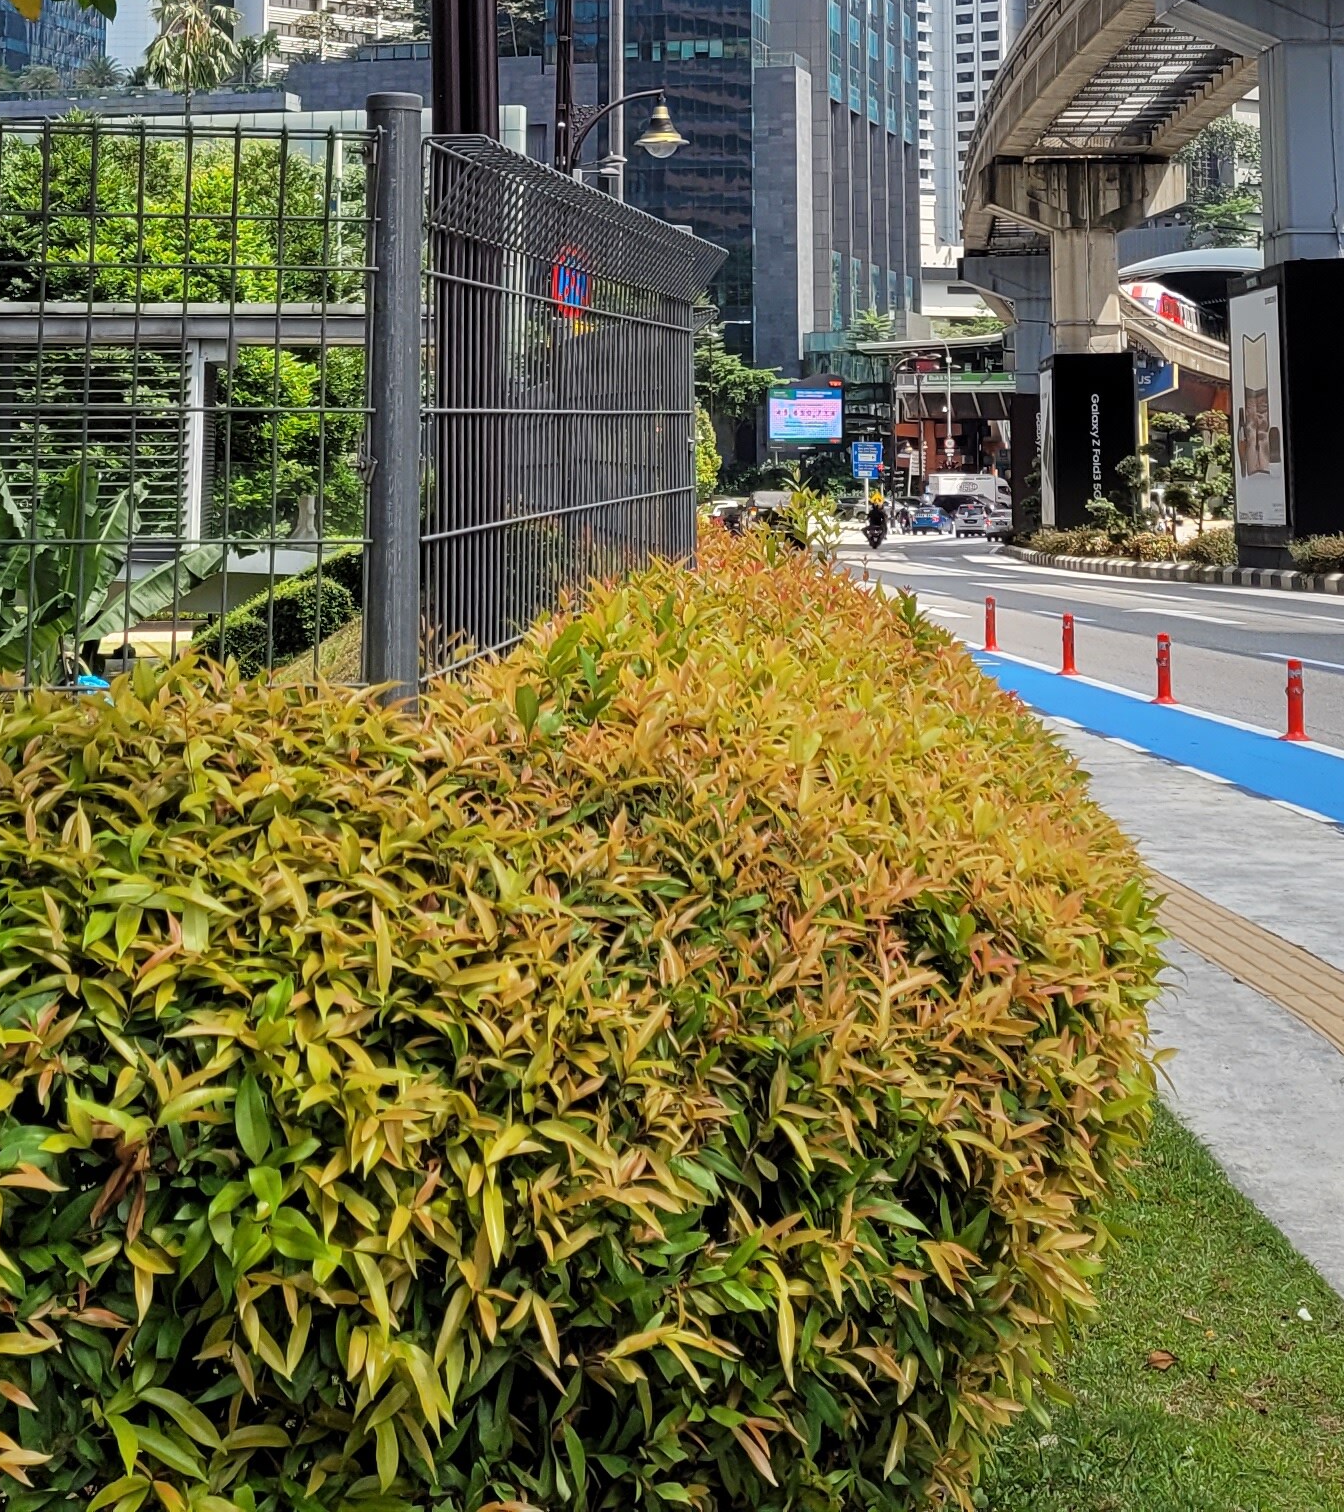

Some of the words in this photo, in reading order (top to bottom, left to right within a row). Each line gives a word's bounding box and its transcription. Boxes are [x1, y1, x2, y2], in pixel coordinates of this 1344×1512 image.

[1089, 393, 1100, 438] Galaxy
[1092, 439, 1101, 447] Z
[1092, 448, 1102, 481] Fold3
